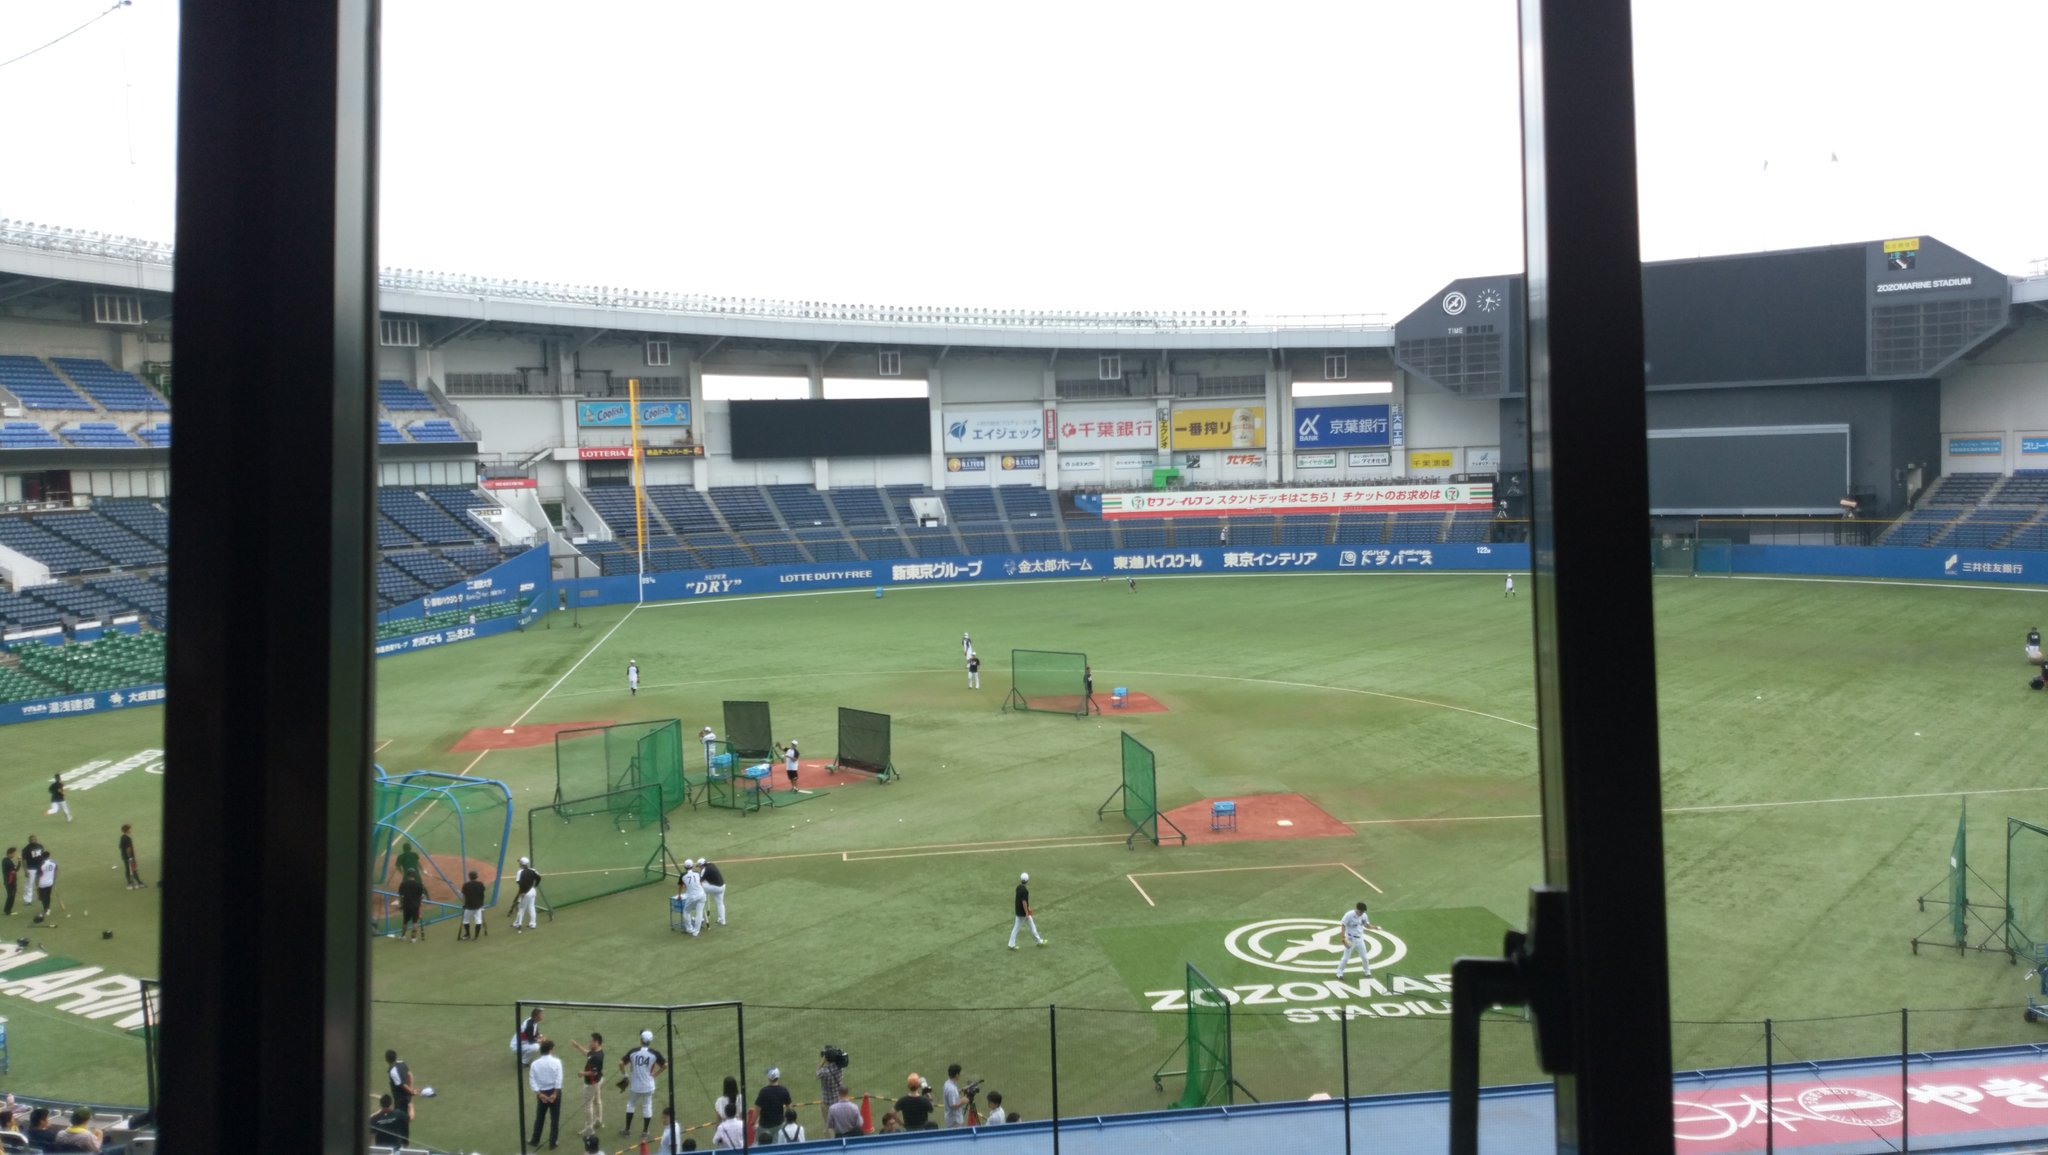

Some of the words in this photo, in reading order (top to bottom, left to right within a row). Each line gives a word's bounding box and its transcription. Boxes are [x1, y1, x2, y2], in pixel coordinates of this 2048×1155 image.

[1877, 280, 1932, 292] ZOZOMARINE
[1933, 277, 1972, 289] STADIUM
[1078, 420, 1153, 437] 千葉銀行
[1175, 421, 1232, 436] 一番搾り
[1330, 418, 1388, 434] 京葉銀行
[972, 427, 1042, 440] エイジェック
[581, 450, 626, 458] LOTTERIA
[1343, 490, 1441, 502] チケットのお求めは
[1113, 554, 1203, 570] 東進ハイスクール
[1223, 552, 1318, 568] 東京インテリア
[1361, 552, 1433, 565] トラバース
[892, 560, 983, 581] 新東京グループ
[1018, 558, 1093, 574] 金太郎ホーム
[1962, 562, 2023, 575] 三井住友銀行
[704, 574, 728, 582] SUPER
[780, 574, 814, 583] LOTTE
[814, 572, 844, 581] DUTY
[845, 570, 873, 579] FREE
[635, 1055, 650, 1067] 104
